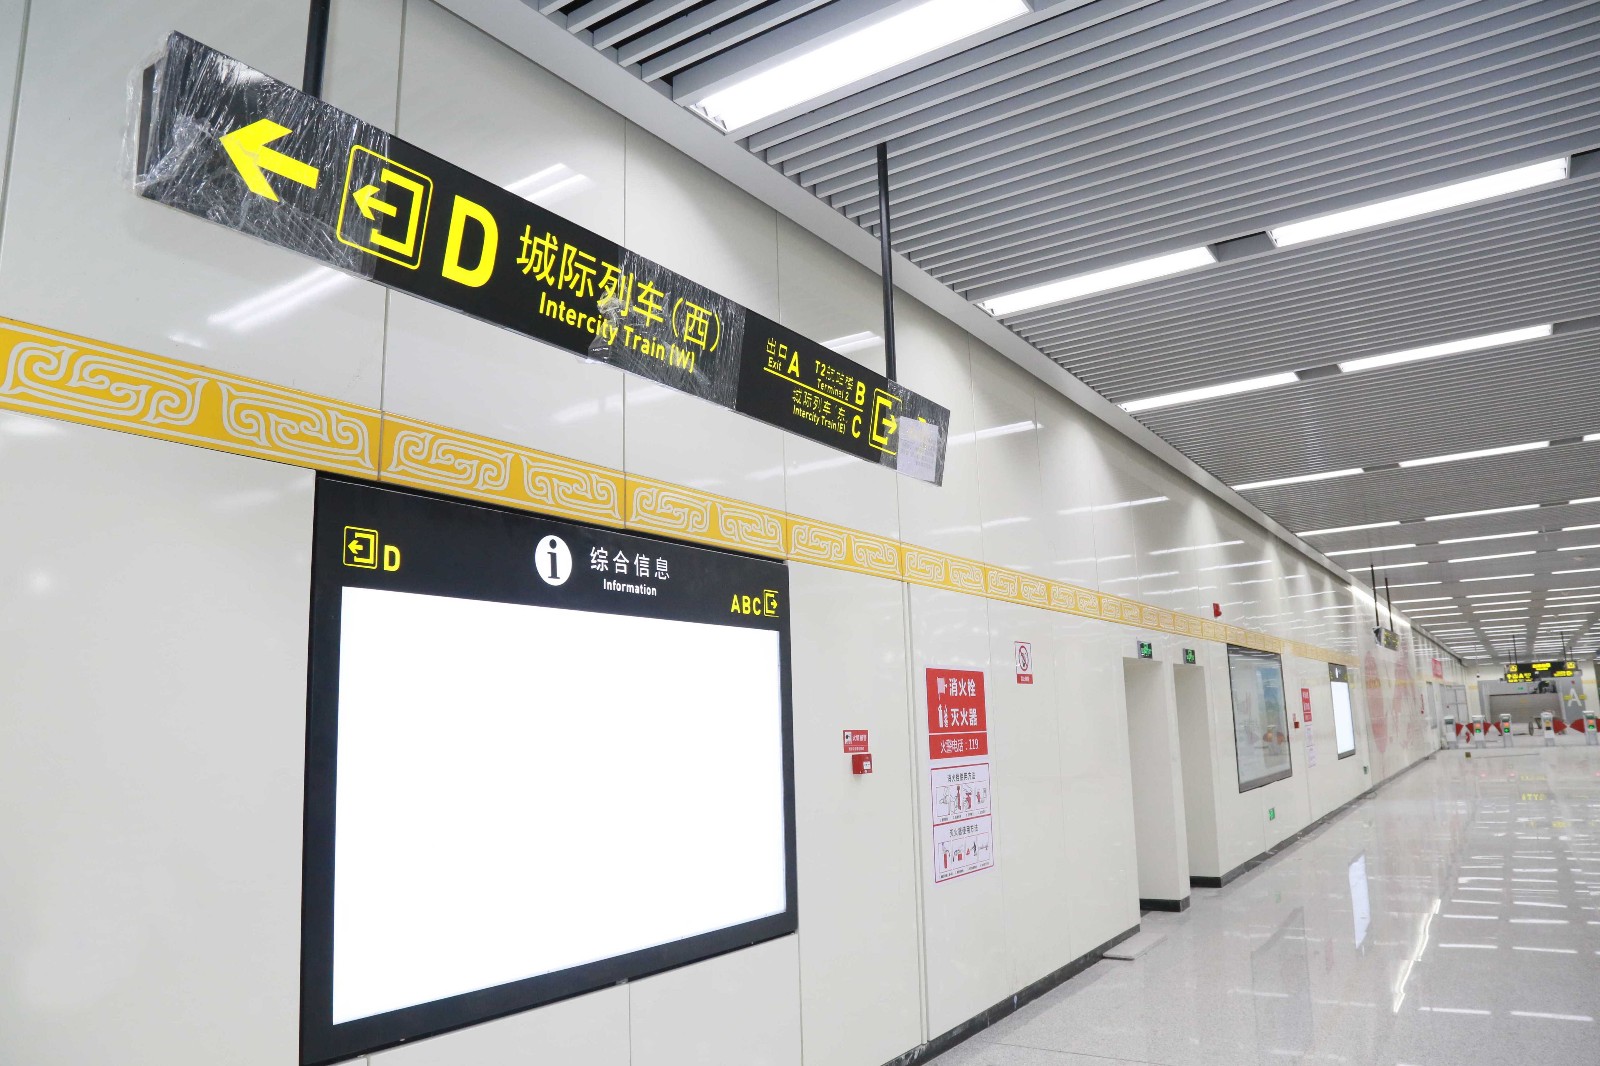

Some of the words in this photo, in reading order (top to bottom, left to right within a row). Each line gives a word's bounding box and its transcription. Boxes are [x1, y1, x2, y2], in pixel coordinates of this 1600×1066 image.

[441, 194, 499, 288] D
[516, 224, 721, 352] 城际列车(西)
[539, 291, 618, 346] Intercity
[623, 326, 666, 361] Train
[668, 342, 695, 374] (W)
[766, 337, 788, 360] 出口
[768, 356, 782, 371] Exit
[787, 350, 800, 378] A
[817, 377, 844, 399] Terminal
[844, 391, 850, 401] 2
[855, 380, 866, 406] B
[793, 404, 820, 426] Intercity
[821, 415, 837, 431] Train
[851, 414, 862, 439] C
[383, 544, 401, 572] D
[589, 546, 670, 580] 综合信息
[603, 578, 657, 597] Information
[949, 677, 977, 697] 消火栓
[950, 706, 978, 727] 灭火器
